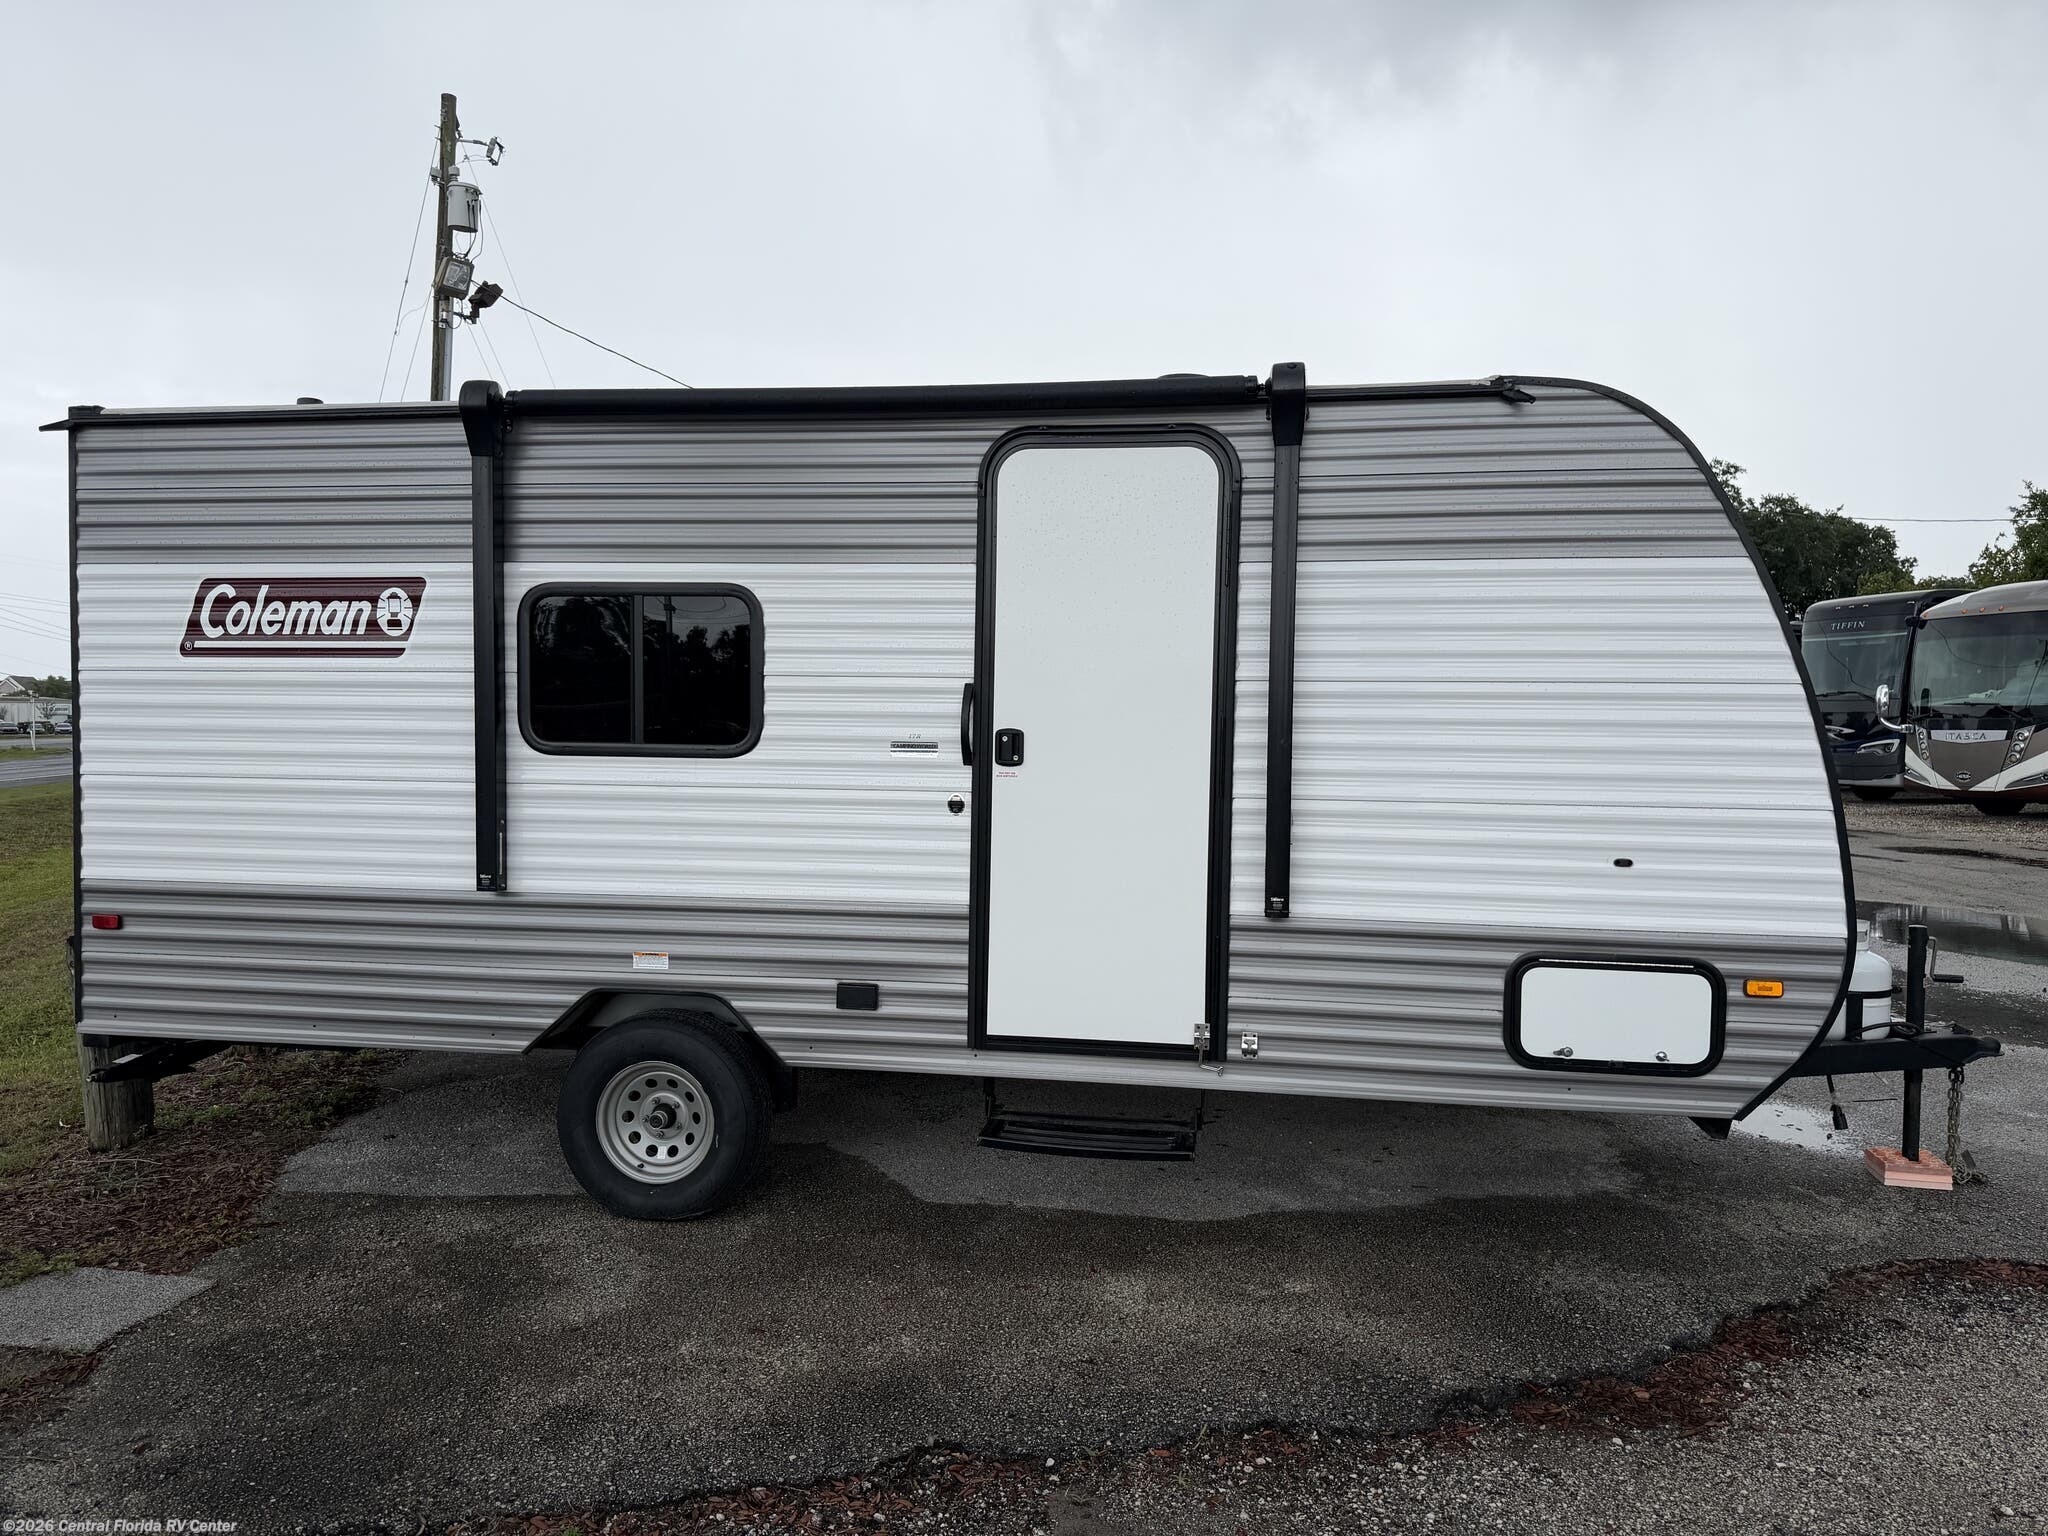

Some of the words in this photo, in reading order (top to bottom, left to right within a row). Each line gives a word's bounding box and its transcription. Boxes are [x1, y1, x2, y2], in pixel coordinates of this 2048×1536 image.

[199, 583, 372, 639] Coleman
[1831, 620, 1866, 631] TIFFIN
[1945, 732, 1987, 741] ITASCA
